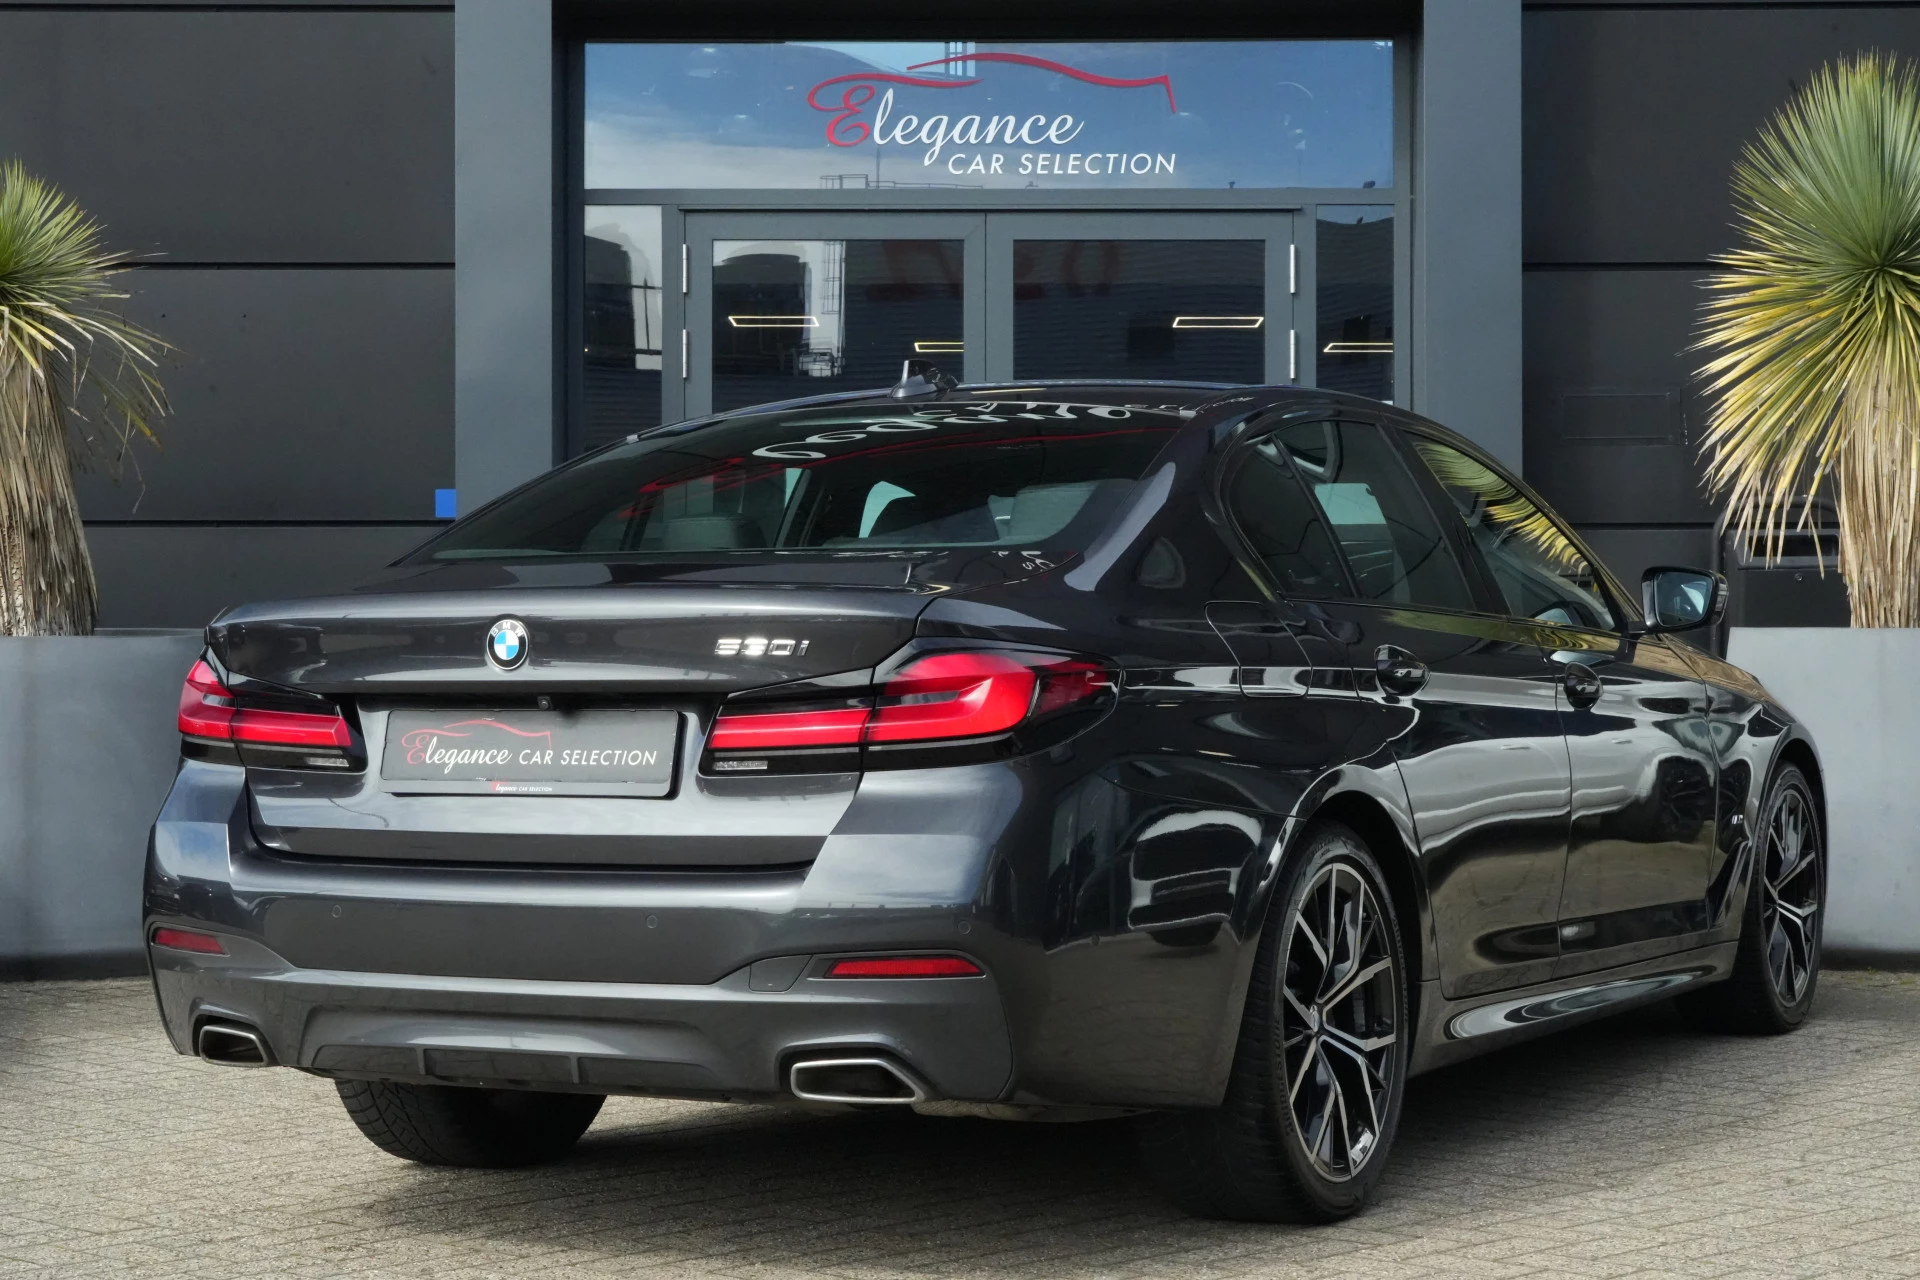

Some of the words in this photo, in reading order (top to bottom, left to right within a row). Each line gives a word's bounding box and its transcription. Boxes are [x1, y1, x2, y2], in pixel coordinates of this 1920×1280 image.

[807, 74, 1085, 167] Elegance
[947, 153, 1004, 175] CAR
[1018, 153, 1177, 175] SELECTION
[490, 621, 525, 638] BMW
[402, 730, 512, 774] Elegance
[518, 749, 554, 766] CAR
[560, 749, 657, 767] SELECTION
